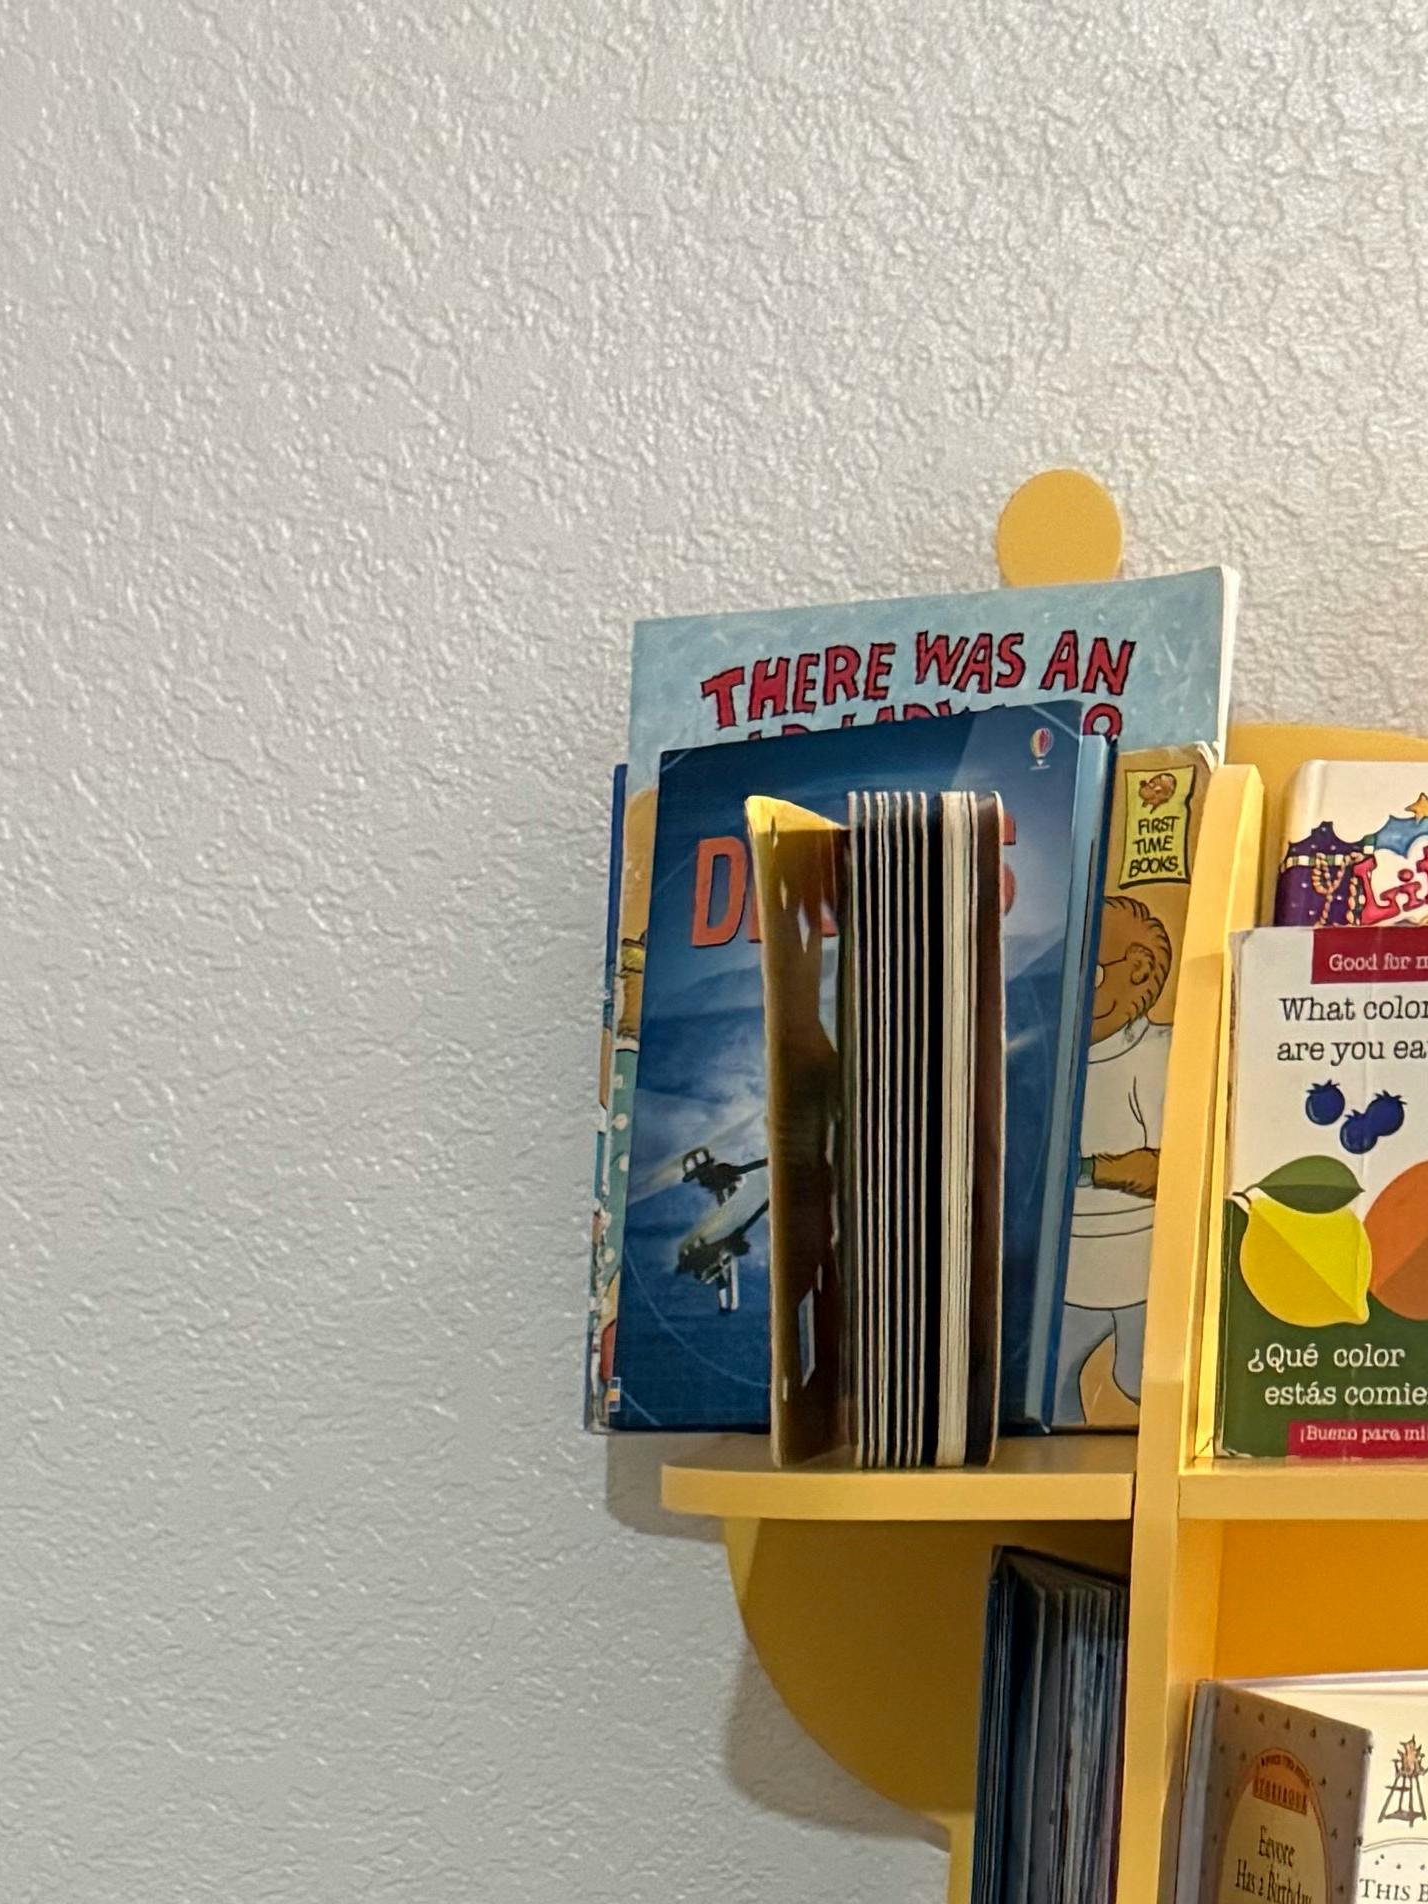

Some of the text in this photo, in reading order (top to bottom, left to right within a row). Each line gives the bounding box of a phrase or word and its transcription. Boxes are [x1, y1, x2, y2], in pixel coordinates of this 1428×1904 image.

[700, 642, 896, 731] THERE
[915, 630, 1025, 694] WAS
[1038, 629, 1136, 696] AN
[1138, 815, 1181, 835] FIRST
[1132, 835, 1174, 854] TIME
[1328, 952, 1378, 972] Good
[1383, 952, 1412, 971] for
[1278, 996, 1356, 1021] What
[1277, 1041, 1324, 1061] are
[1330, 1041, 1386, 1066] you
[1247, 1342, 1406, 1373] ¿Qué color
[1264, 1381, 1336, 1406] estás
[1362, 1428, 1400, 1444] para
[1359, 1878, 1411, 1901] THIS
